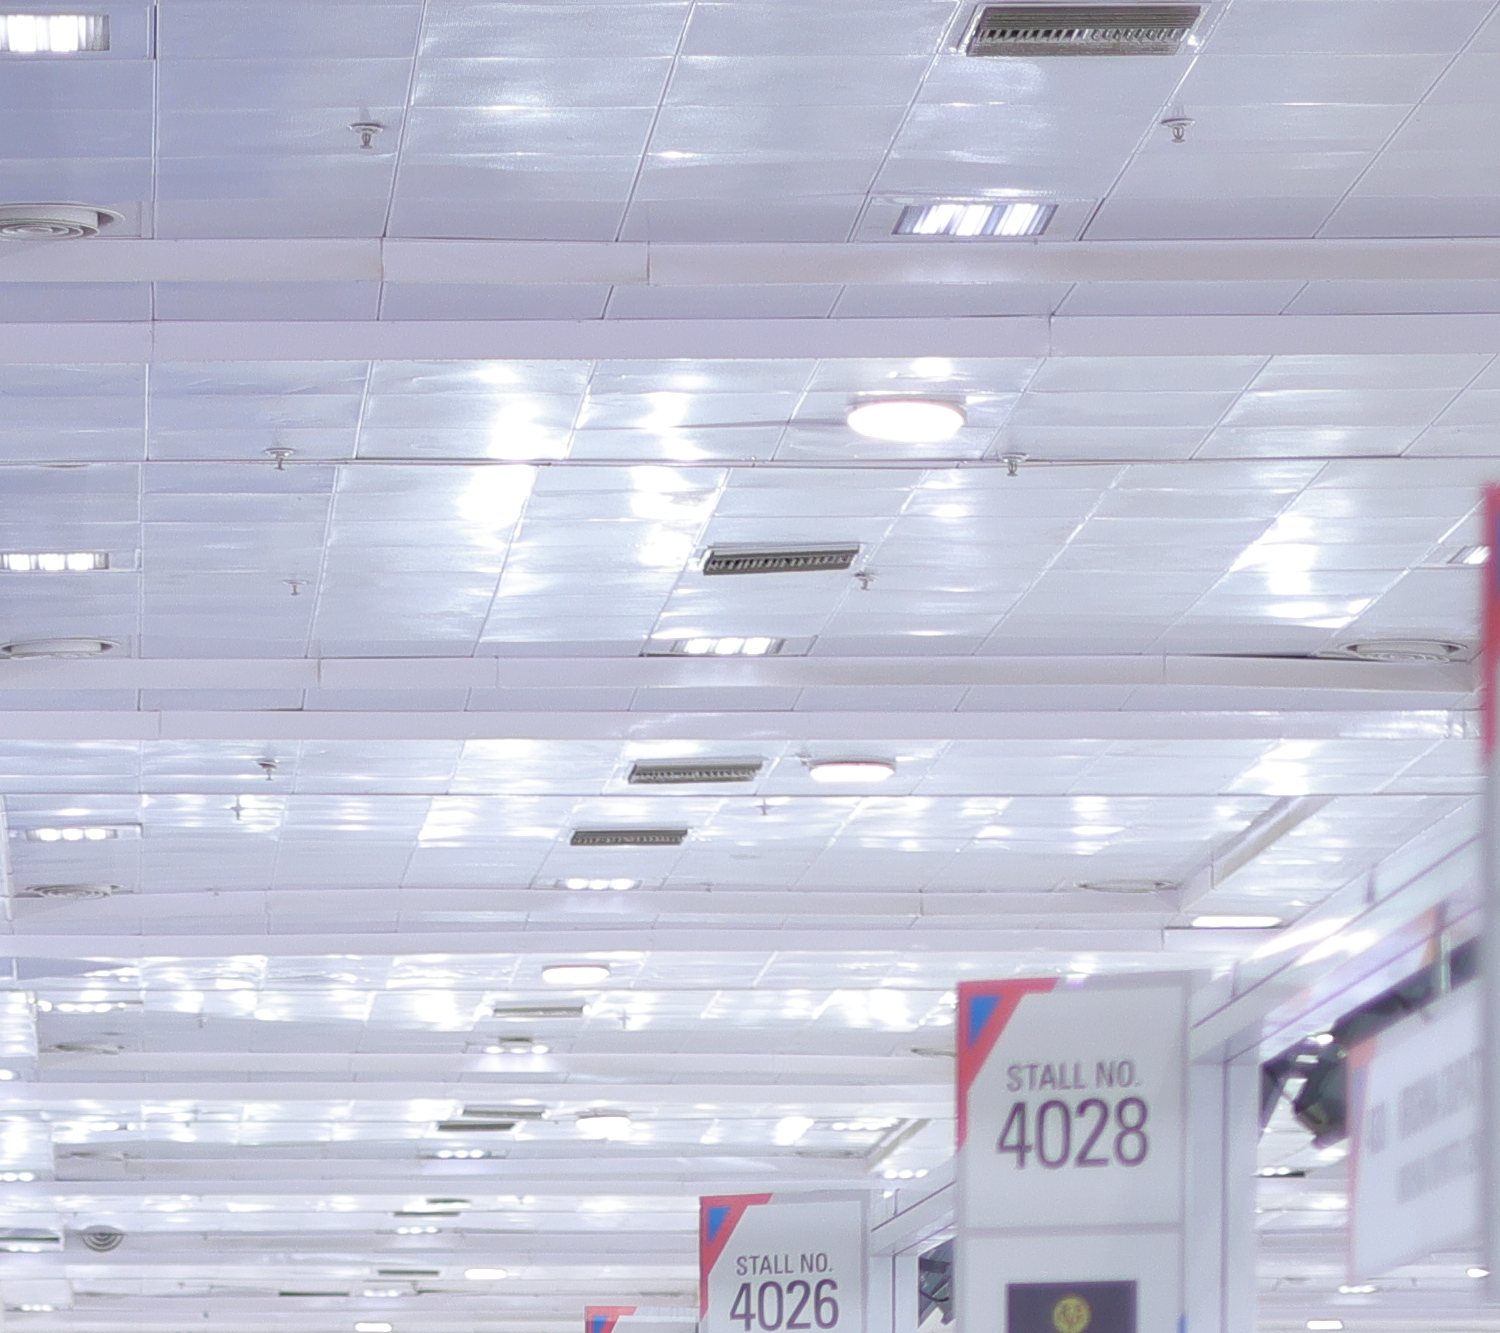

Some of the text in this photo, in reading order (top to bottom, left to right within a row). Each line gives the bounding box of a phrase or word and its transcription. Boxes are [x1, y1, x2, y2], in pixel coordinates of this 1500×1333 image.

[1006, 1059, 1142, 1092] STALL NO.
[995, 1096, 1149, 1171] 4028
[736, 1252, 833, 1276] STALL NO.
[729, 1278, 839, 1332] 4026
